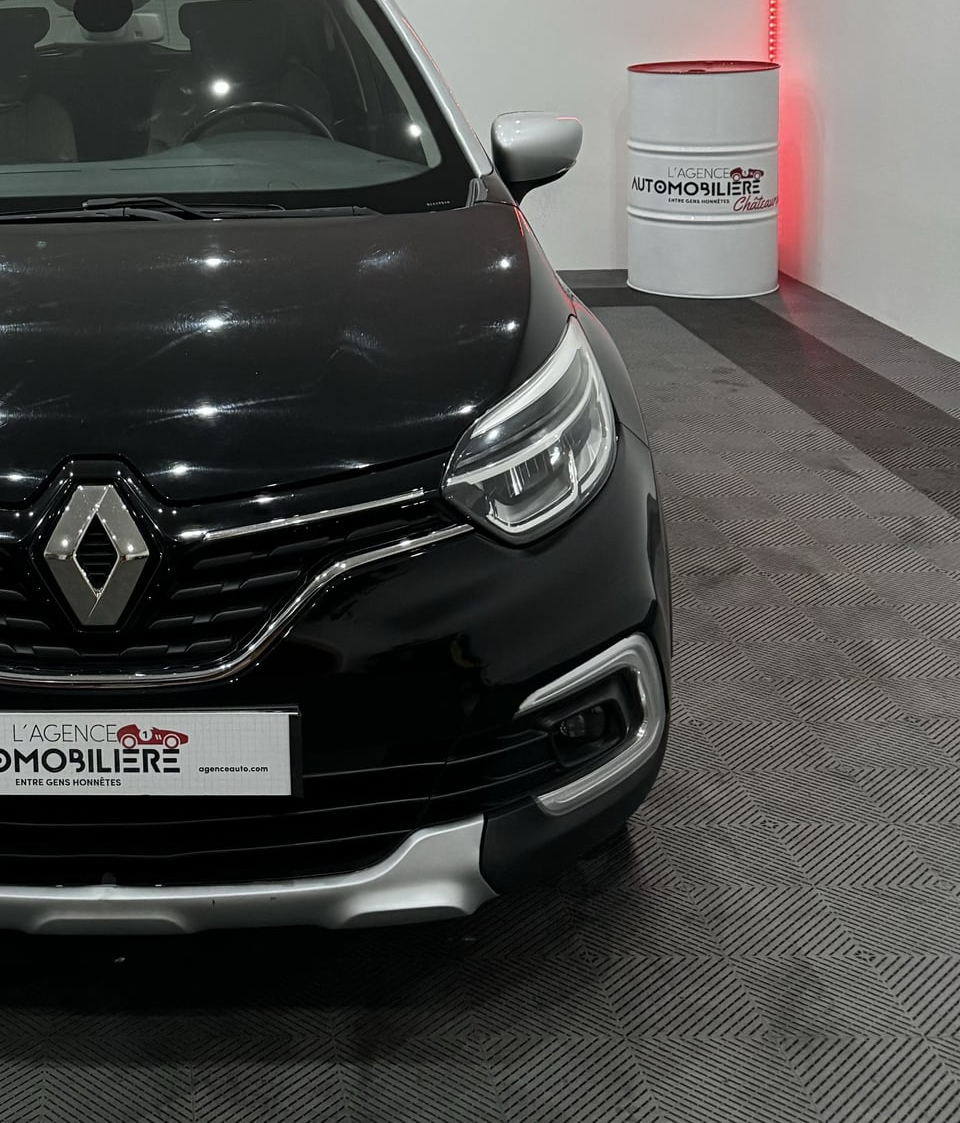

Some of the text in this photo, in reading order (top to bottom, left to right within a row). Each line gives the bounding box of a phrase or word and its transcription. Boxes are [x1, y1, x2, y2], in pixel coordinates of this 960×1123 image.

[143, 731, 148, 739] 1
[198, 765, 269, 774] agenceauto.com
[15, 776, 122, 786] ENTRE GENS HONNÊTES
